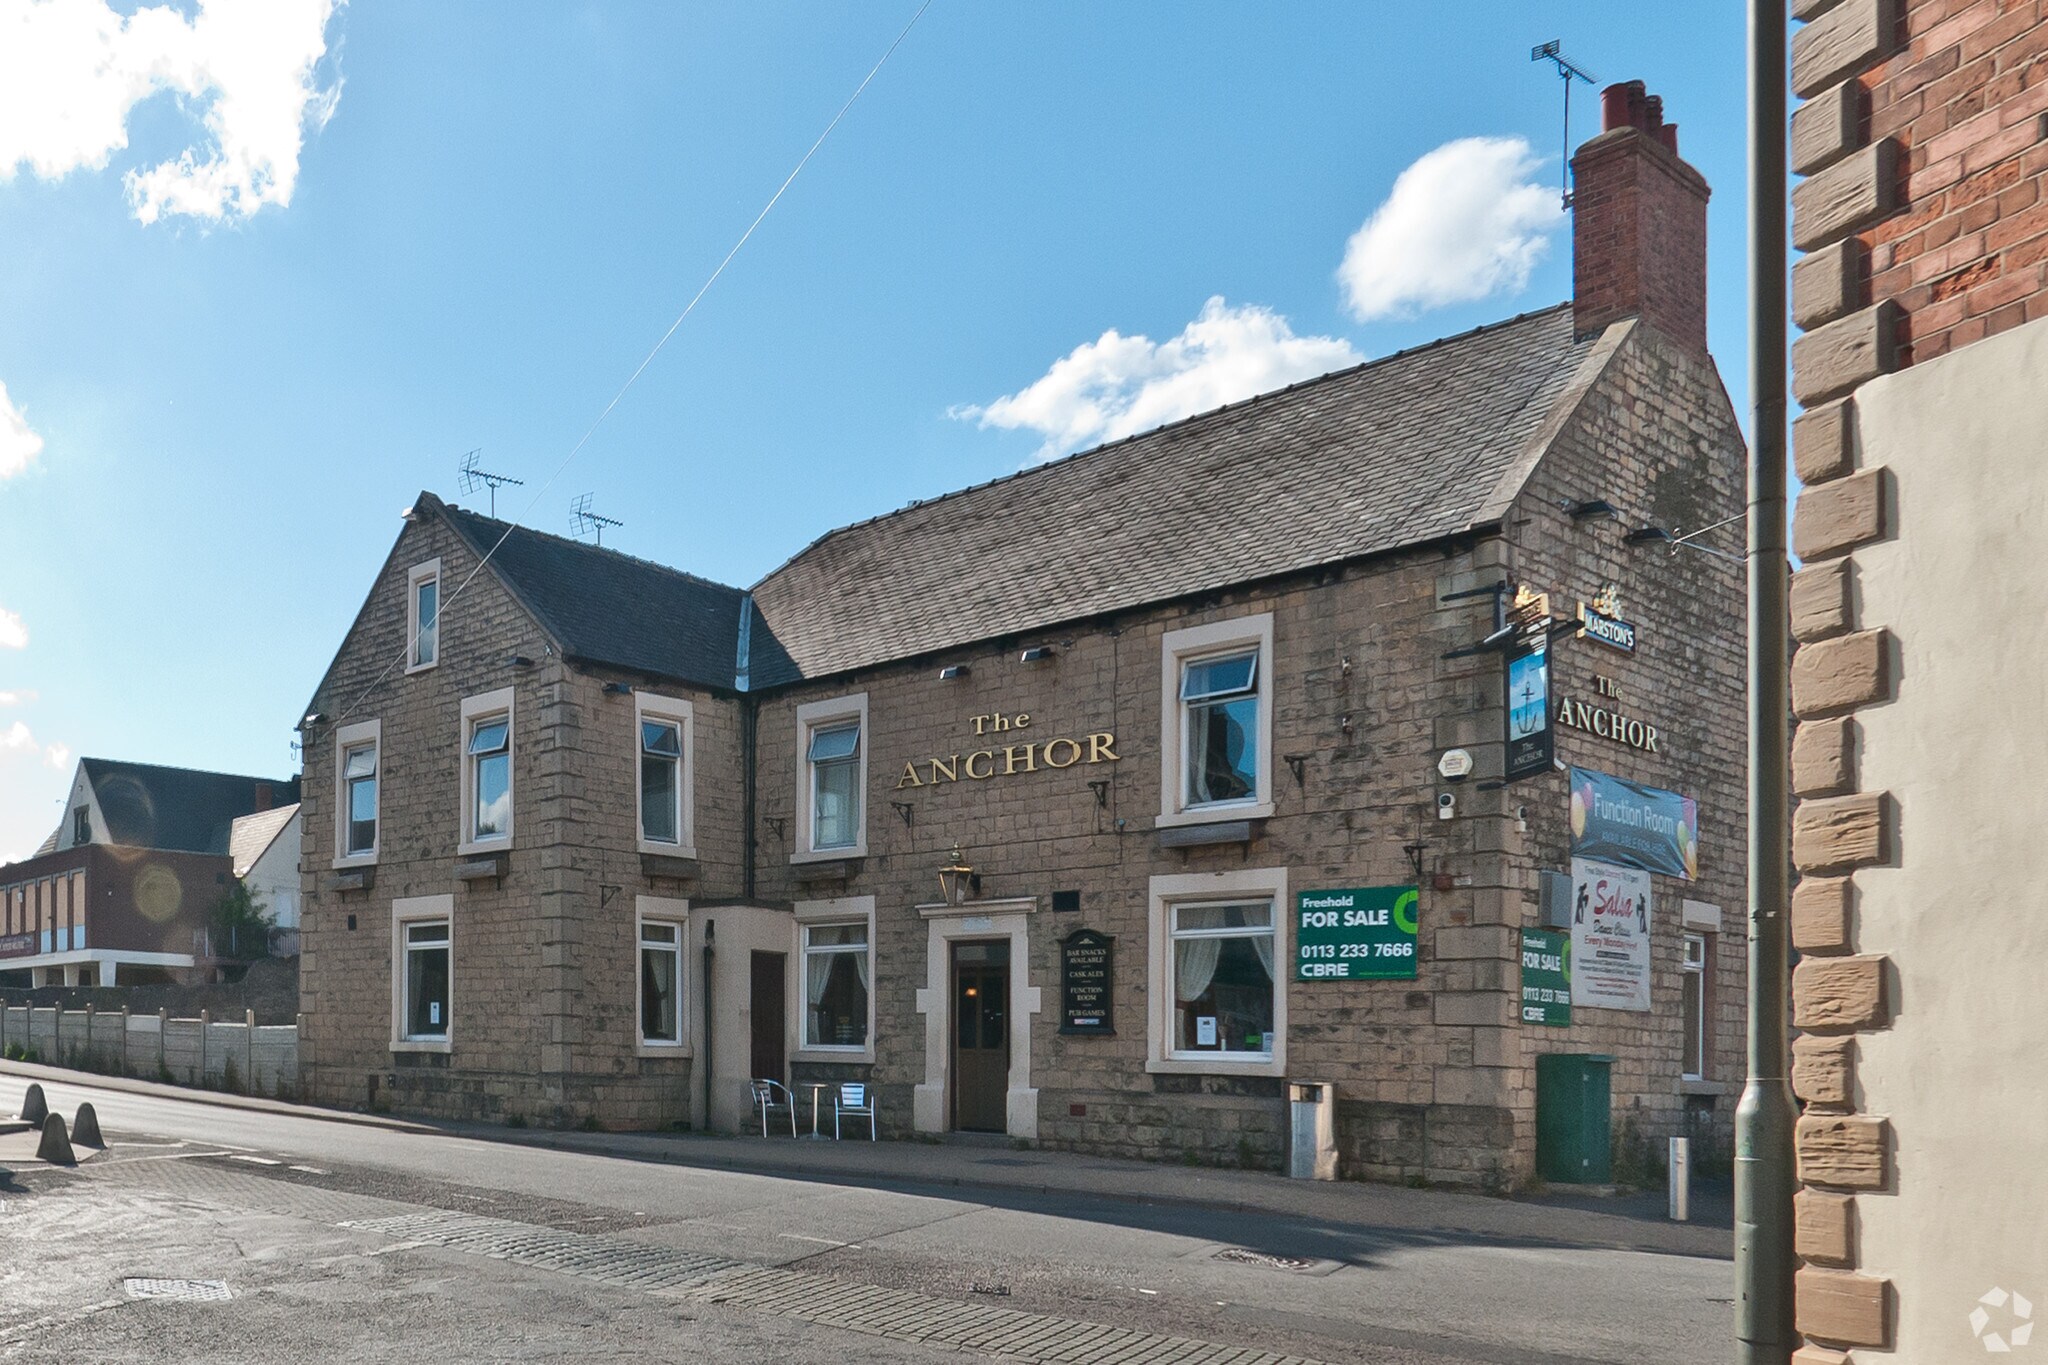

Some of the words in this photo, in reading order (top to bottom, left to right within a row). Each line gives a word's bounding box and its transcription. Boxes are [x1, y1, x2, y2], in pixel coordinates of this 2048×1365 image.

[1585, 613, 1634, 647] MARSTON'S
[1596, 675, 1623, 700] The
[970, 713, 1030, 735] The
[1558, 697, 1657, 752] ANCHOR
[896, 733, 1120, 788] ANCHOR
[1513, 750, 1543, 766] ANCHOR
[1594, 793, 1641, 827] Function
[1644, 805, 1674, 835] Room
[1303, 896, 1354, 908] Freehold
[1594, 880, 1633, 918] Salsa
[1302, 911, 1339, 928] FOR
[1343, 909, 1389, 927] SALE
[1066, 949, 1080, 957] BAR
[1081, 948, 1107, 956] SNACKS
[1301, 944, 1335, 958] 0113
[1339, 944, 1369, 958] 233
[1374, 943, 1413, 957] 7666
[1300, 963, 1349, 977] CBRE
[1522, 951, 1540, 969] FOR
[1541, 954, 1561, 972] SALE
[1523, 986, 1540, 1001] 0113
[1541, 988, 1553, 1003] 233
[1068, 1009, 1081, 1017] PUB
[1082, 1009, 1106, 1017] GAMES
[1522, 1006, 1545, 1021] CBRE
